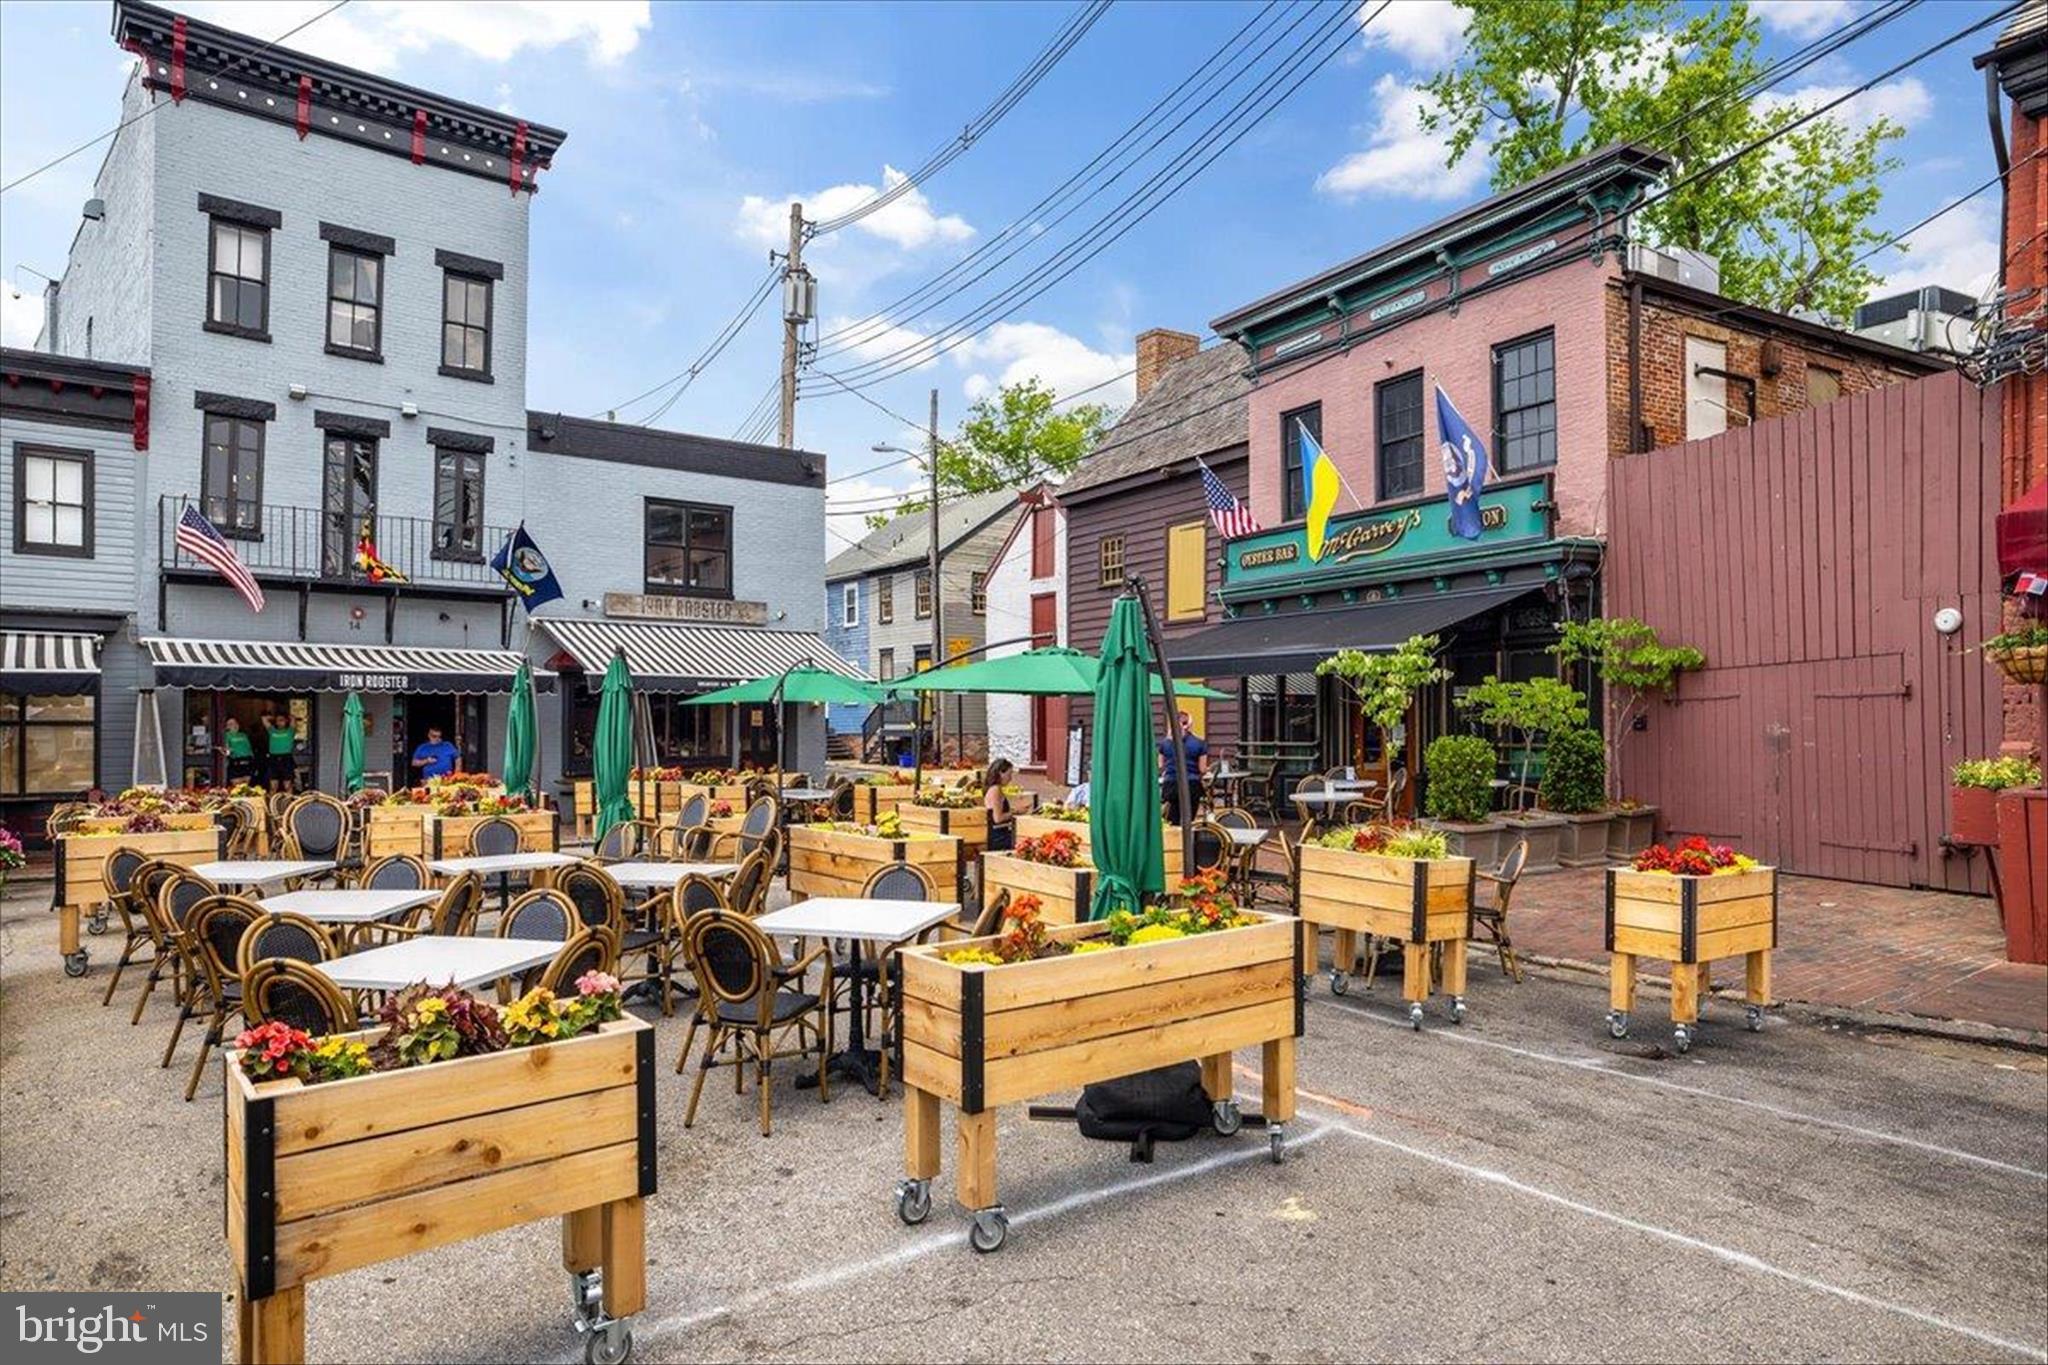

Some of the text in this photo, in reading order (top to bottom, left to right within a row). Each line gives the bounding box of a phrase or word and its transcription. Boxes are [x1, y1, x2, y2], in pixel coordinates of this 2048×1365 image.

[1275, 546, 1295, 561] BAR
[676, 601, 731, 618] ROOSTER
[349, 621, 360, 630] 14
[340, 674, 408, 688] IRON ROOSTER
